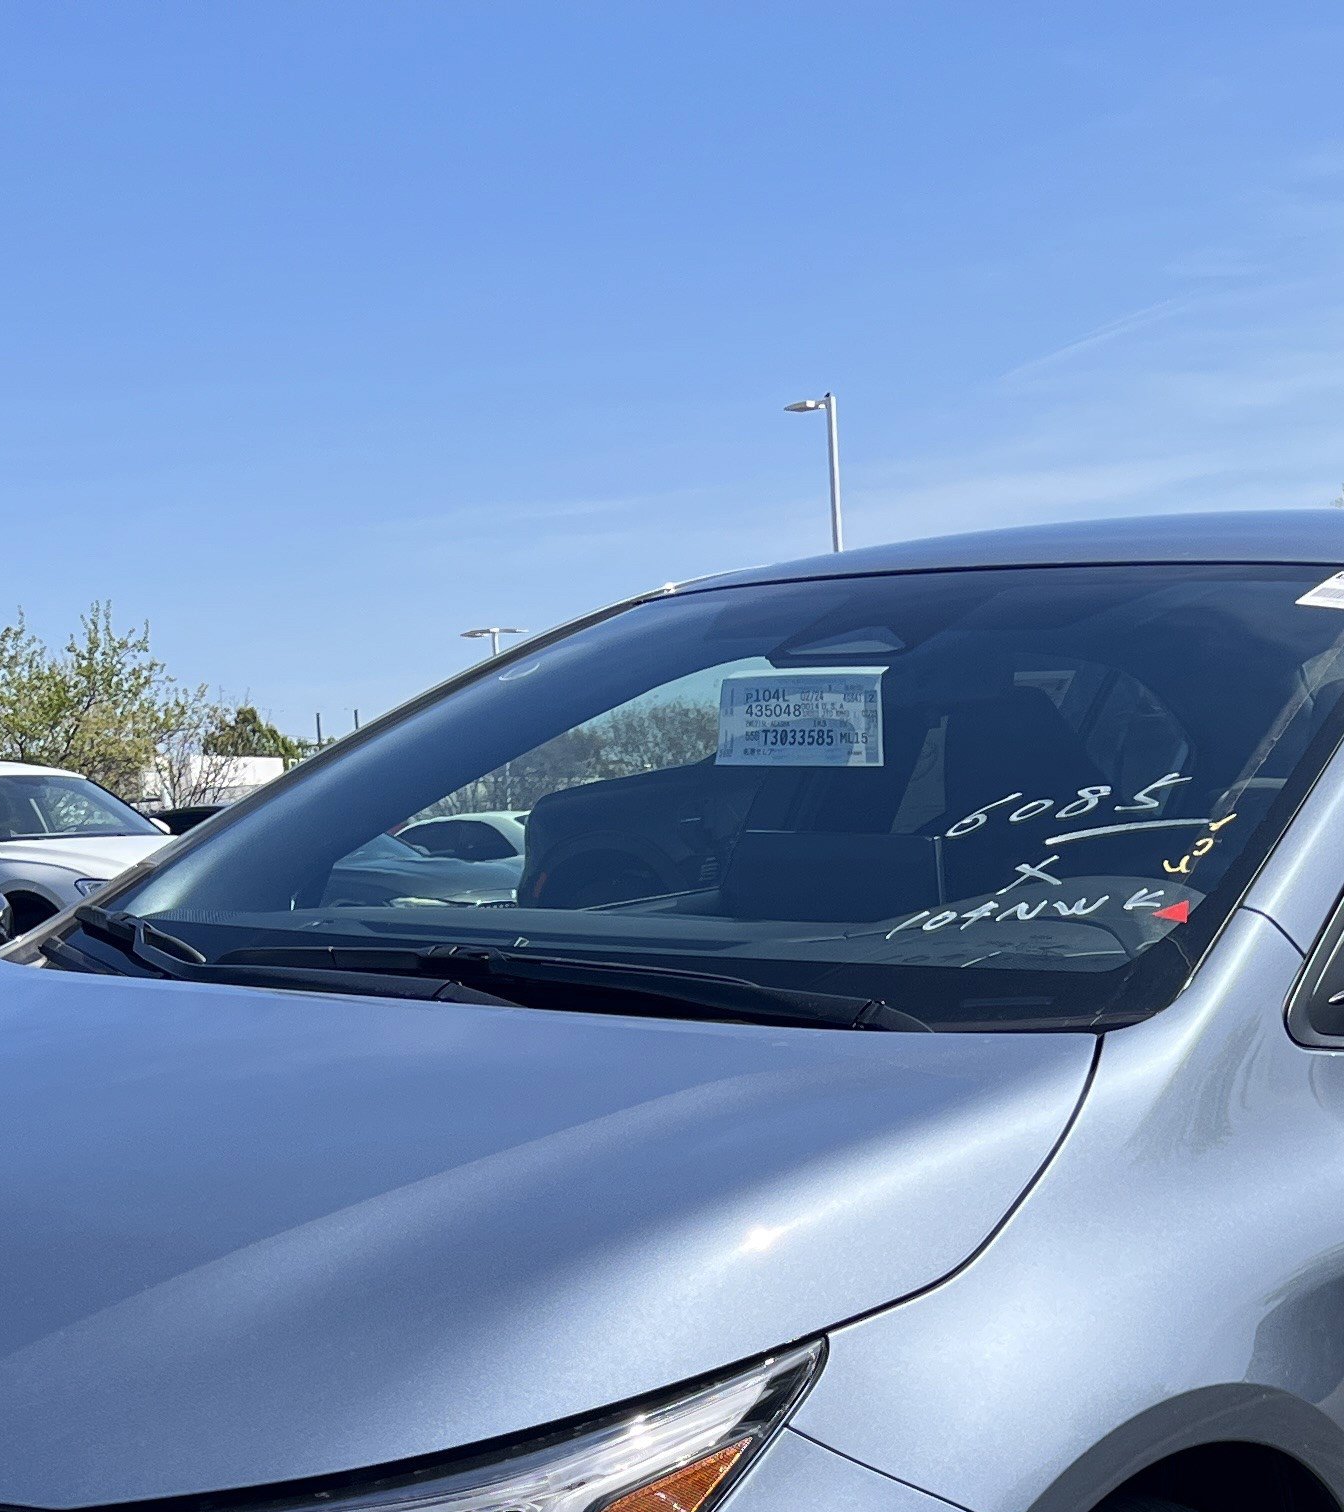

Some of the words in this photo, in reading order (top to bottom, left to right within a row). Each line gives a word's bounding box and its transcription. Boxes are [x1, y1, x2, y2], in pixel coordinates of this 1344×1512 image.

[745, 704, 801, 718] 435048
[762, 729, 834, 746] T3033585
[945, 772, 1193, 838] 6085
